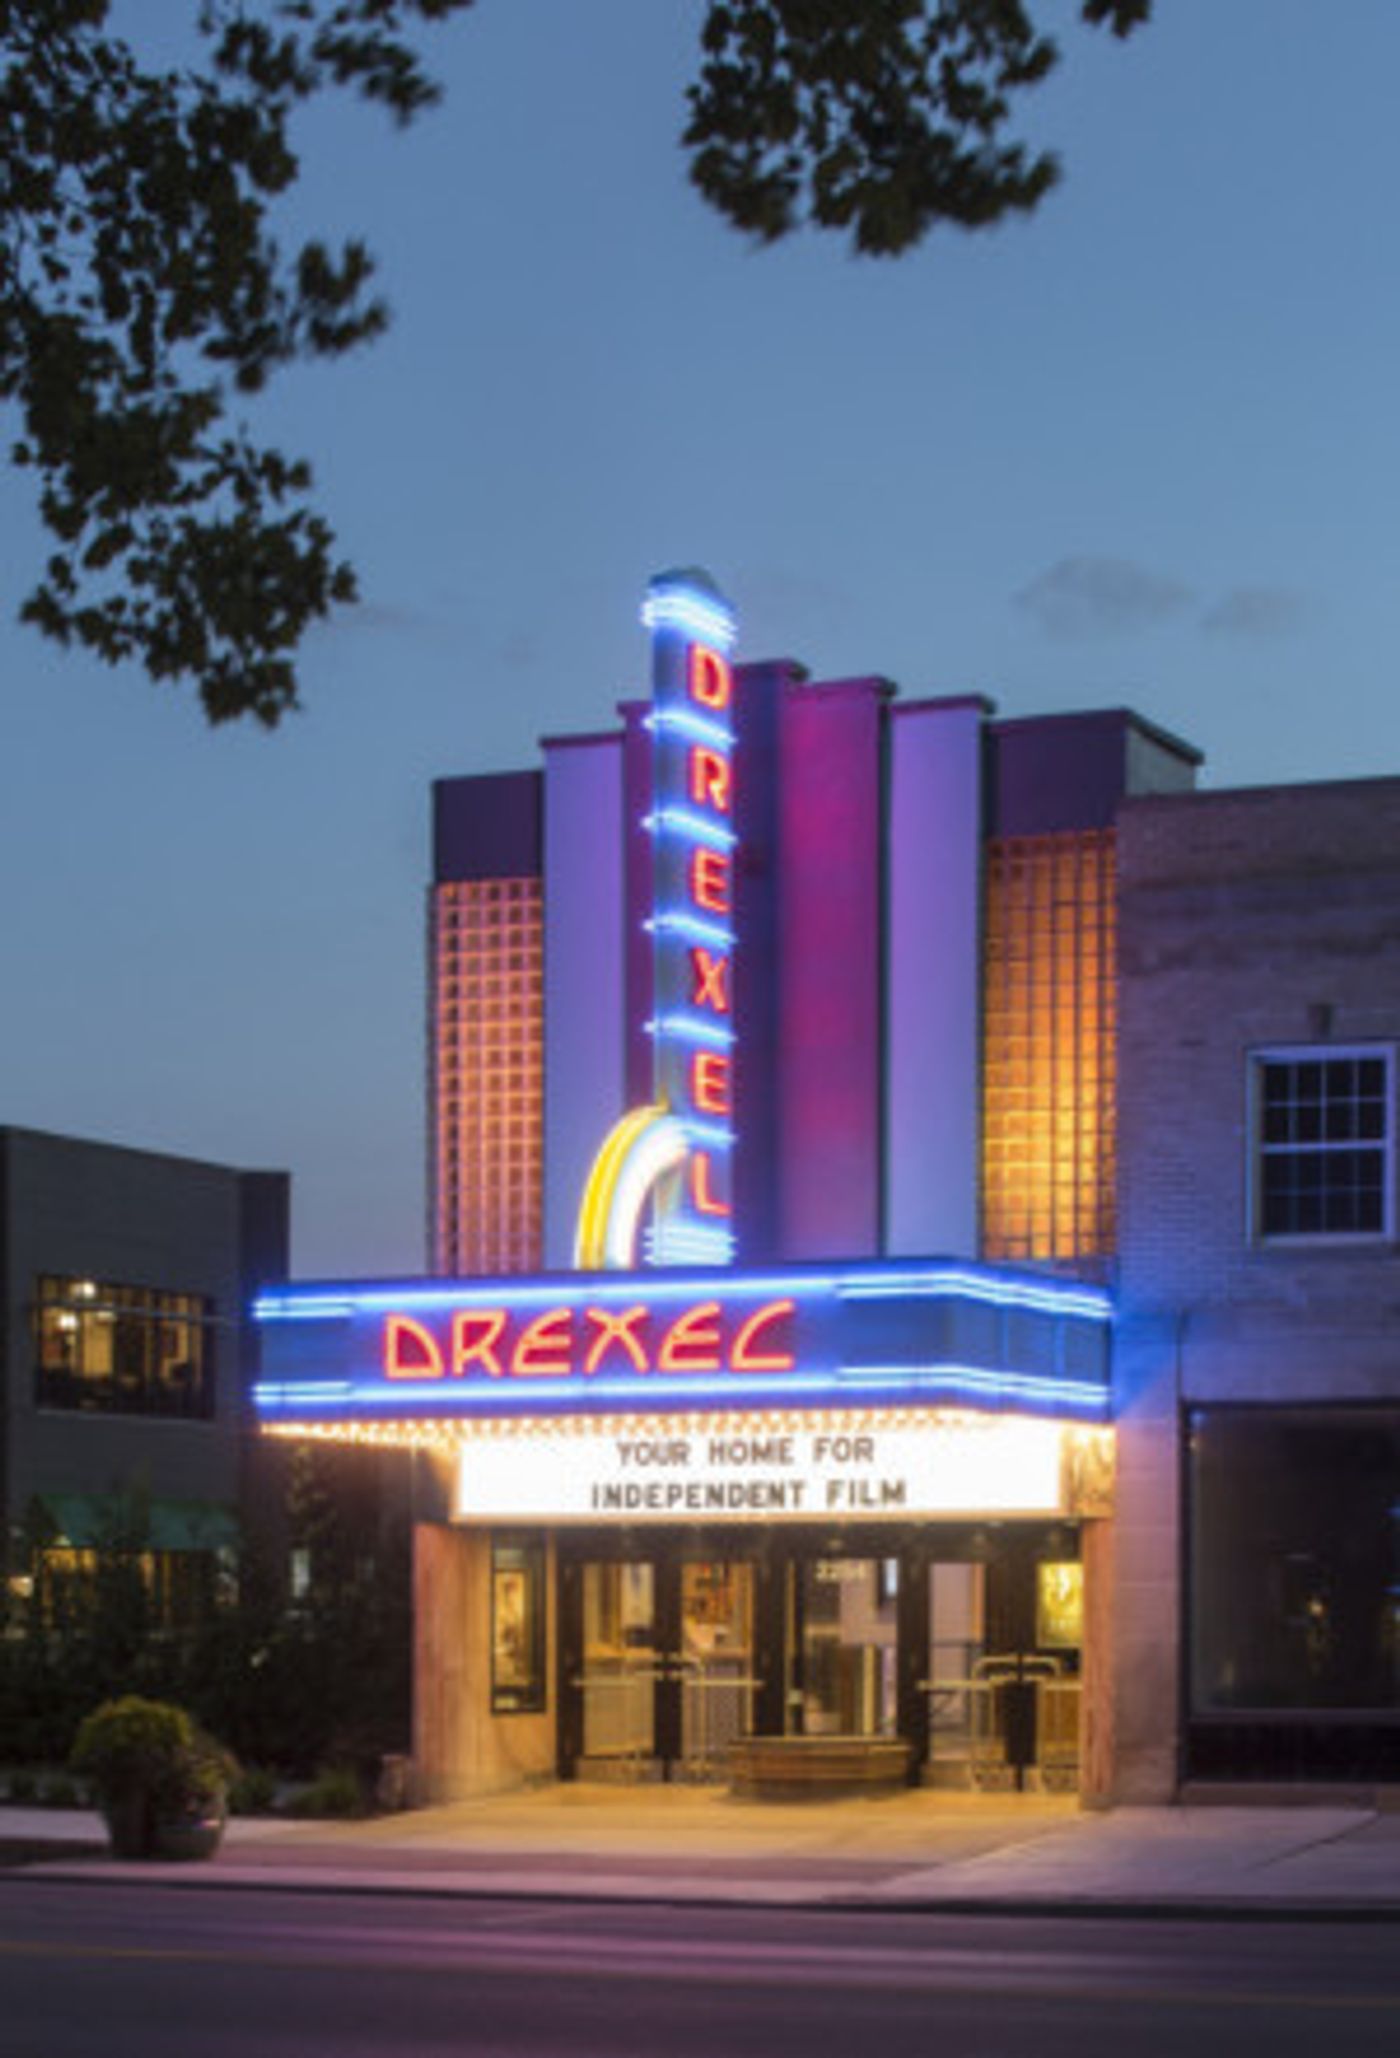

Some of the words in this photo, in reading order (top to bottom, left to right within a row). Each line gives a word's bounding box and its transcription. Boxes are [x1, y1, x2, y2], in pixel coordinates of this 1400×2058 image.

[687, 642, 731, 1217] DREXEL
[616, 1440, 692, 1467] YOUR
[708, 1437, 795, 1465] HOME
[812, 1436, 875, 1464] FOR
[592, 1482, 805, 1509] INDEPENDENT
[826, 1479, 906, 1506] FILM
